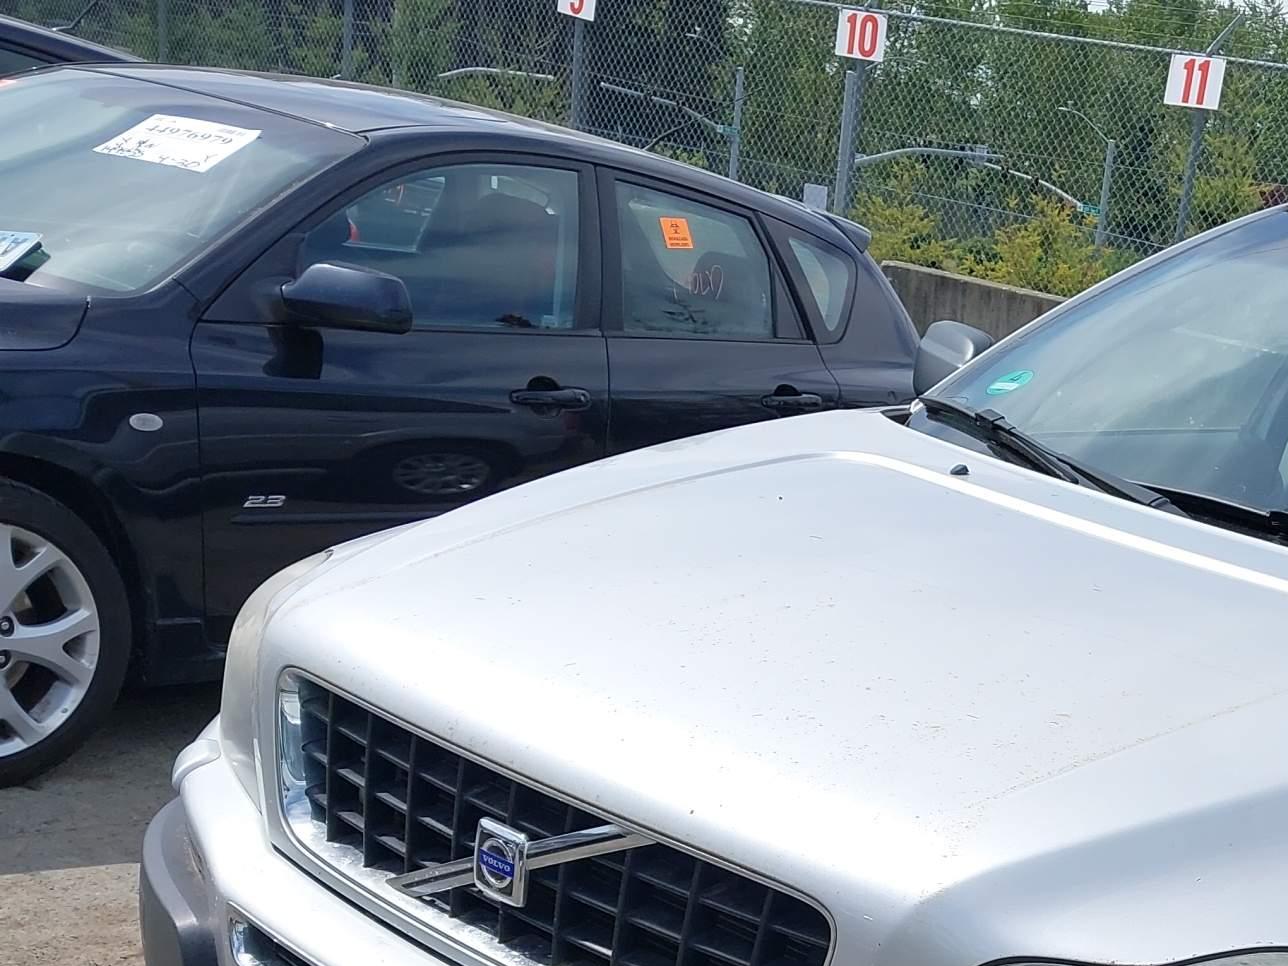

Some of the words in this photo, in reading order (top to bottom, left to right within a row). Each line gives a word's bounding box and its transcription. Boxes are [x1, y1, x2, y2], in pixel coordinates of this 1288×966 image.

[847, 13, 878, 58] 10
[1182, 58, 1211, 106] 11
[482, 854, 511, 872] VOLVO
